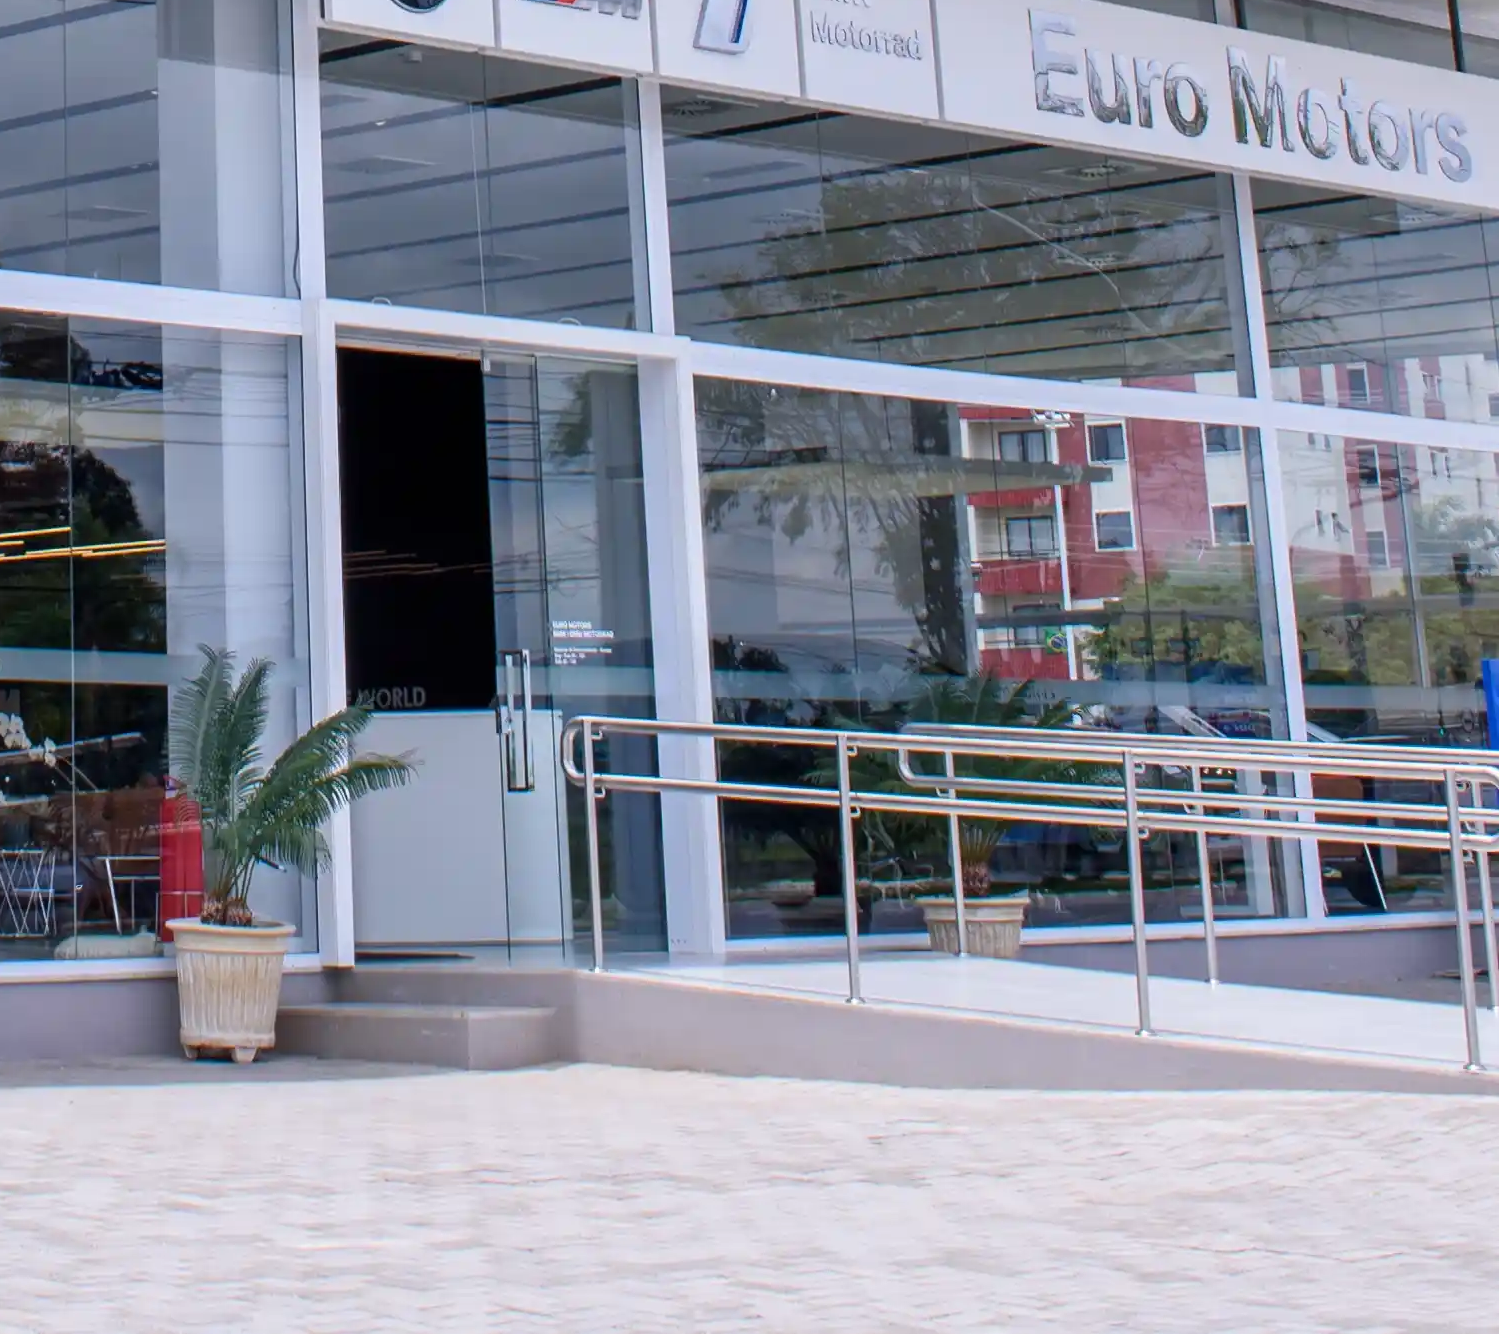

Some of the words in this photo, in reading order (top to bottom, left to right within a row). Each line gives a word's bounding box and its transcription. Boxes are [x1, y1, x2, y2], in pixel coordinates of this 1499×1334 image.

[810, 9, 923, 61] Motorrad
[1028, 8, 1209, 137] Euro
[1225, 44, 1474, 184] Motors
